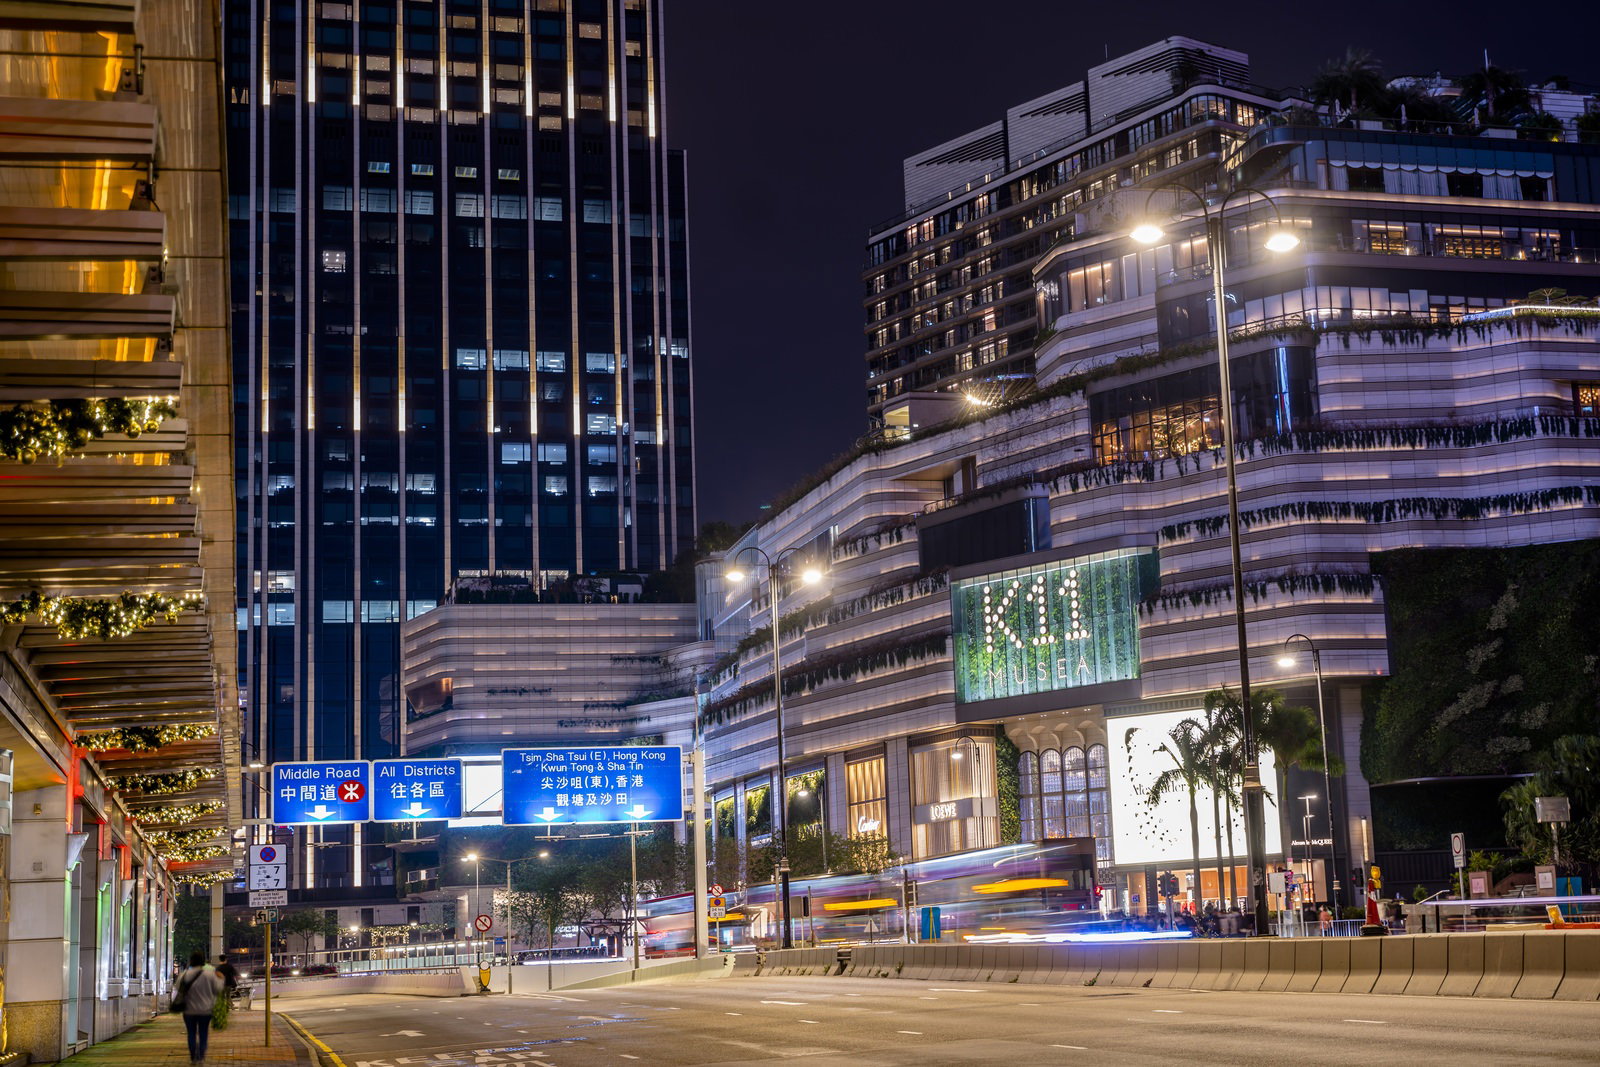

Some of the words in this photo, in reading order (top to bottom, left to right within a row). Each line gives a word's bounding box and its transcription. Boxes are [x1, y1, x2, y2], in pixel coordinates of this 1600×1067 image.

[983, 569, 1091, 653] K11
[988, 655, 1091, 688] MUSEA
[520, 753, 542, 762] Tsim
[546, 752, 564, 762] Sha
[568, 752, 587, 761] Tsui
[590, 751, 610, 762] (E),
[613, 751, 637, 762] Hong
[641, 751, 666, 761] Kong
[279, 767, 320, 780] Middle
[325, 767, 360, 779] Road
[380, 766, 396, 778] All
[404, 765, 456, 777] Districts
[541, 763, 567, 773] Kwun
[570, 762, 594, 773] Tong
[597, 762, 605, 771] &
[607, 762, 626, 771] Sha
[629, 761, 644, 771] Tin
[280, 783, 337, 802] 中間道
[390, 781, 445, 799] 往各區
[556, 792, 628, 807] 觀塘及沙田
[273, 865, 280, 874] 7
[274, 879, 280, 887] 7
[269, 912, 276, 921] P
